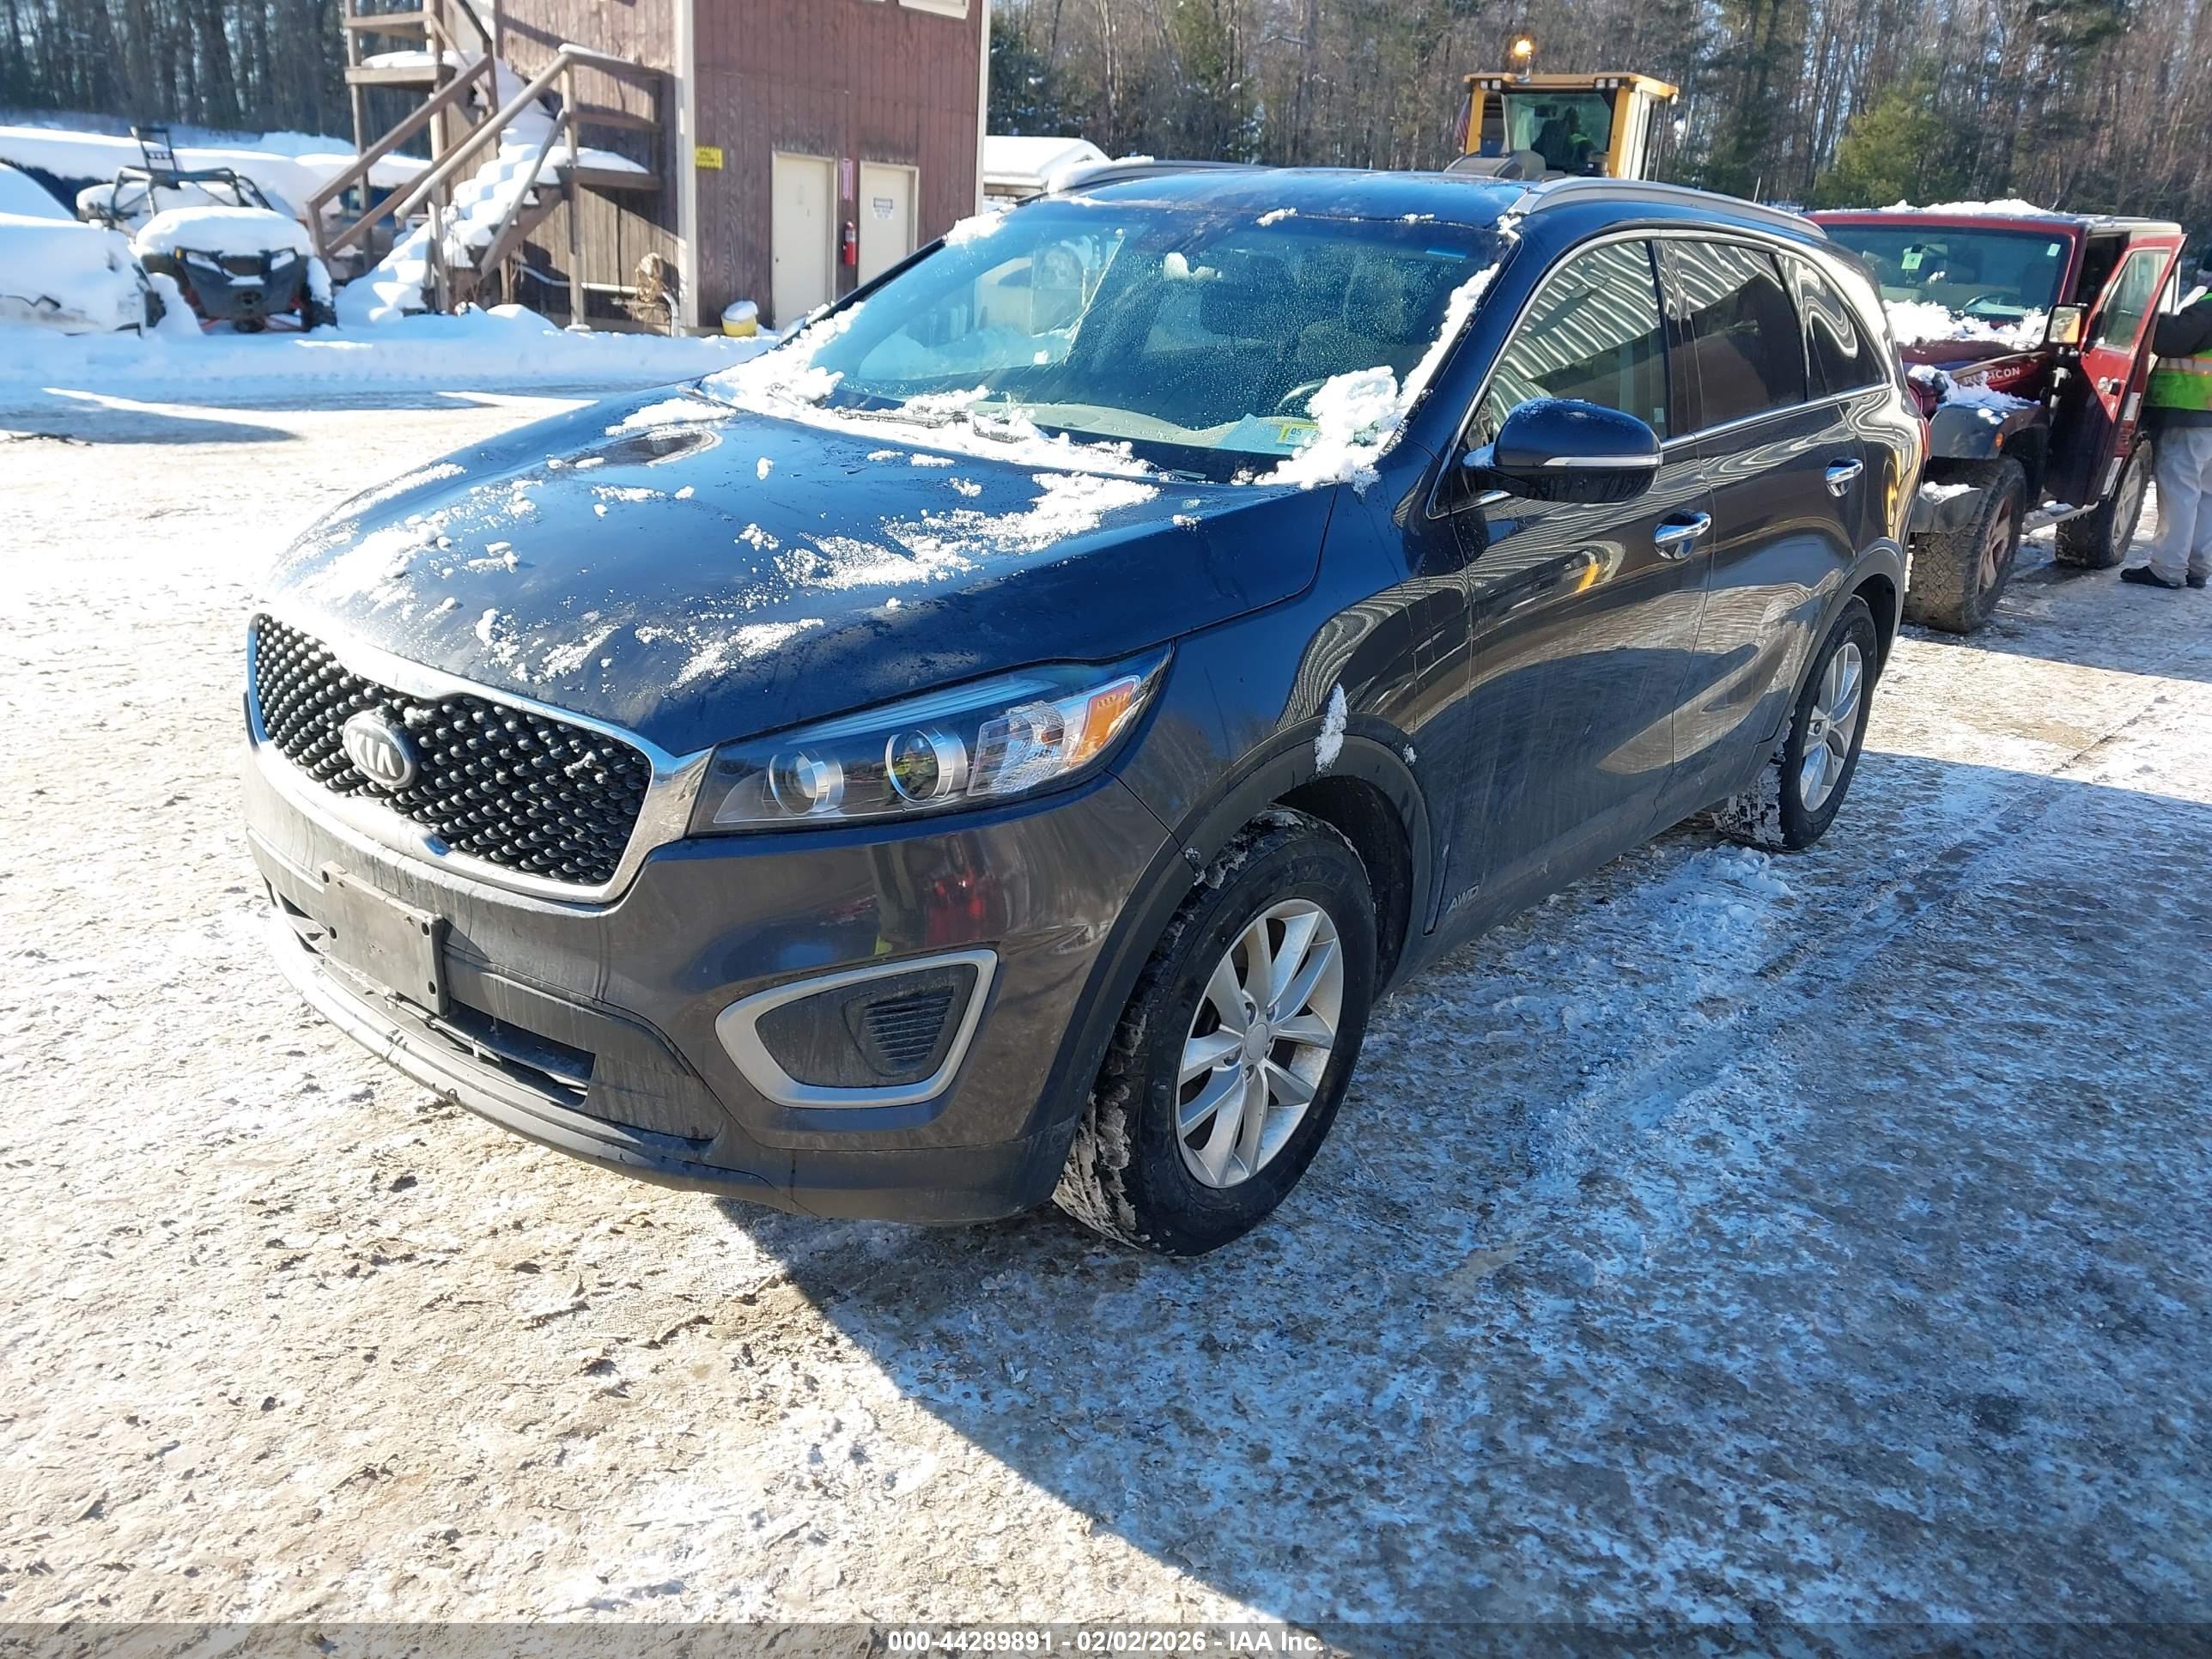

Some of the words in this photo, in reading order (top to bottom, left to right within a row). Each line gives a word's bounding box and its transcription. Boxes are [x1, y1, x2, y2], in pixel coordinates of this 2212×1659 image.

[1964, 367, 2021, 386] RUICON
[1291, 428, 1302, 436] 05
[348, 728, 398, 778] KIA
[1445, 884, 1479, 915] AWD
